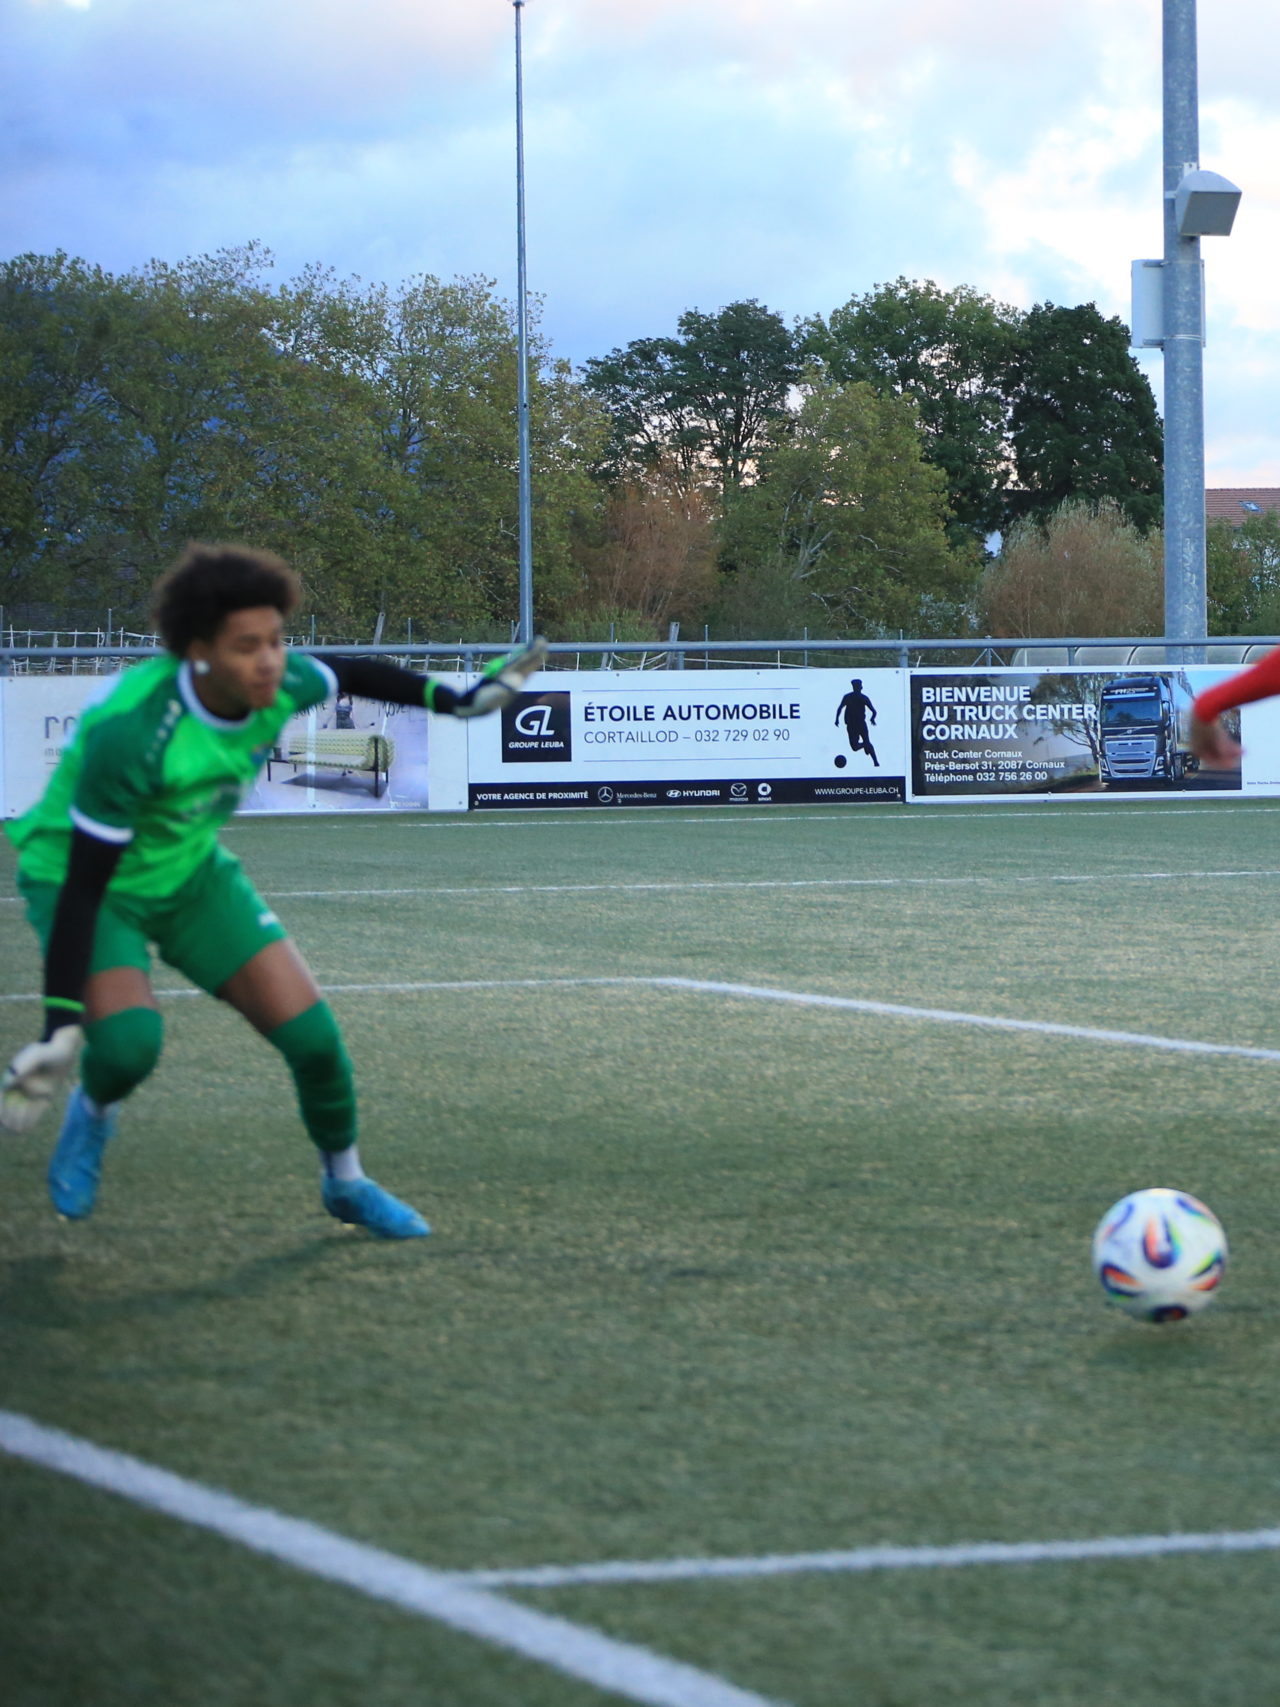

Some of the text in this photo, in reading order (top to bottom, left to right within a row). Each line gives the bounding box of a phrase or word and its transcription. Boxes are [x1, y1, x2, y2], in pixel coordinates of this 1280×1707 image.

[922, 686, 1031, 703] BIENVENUE
[584, 702, 800, 721] ÉTOILE AUTOMOBILE
[922, 704, 1097, 722] AU TRUCK CENTER
[515, 705, 555, 736] GL
[584, 730, 678, 744] CORTAILLOD
[695, 730, 720, 742] 032
[724, 729, 748, 741] 729
[753, 729, 769, 741] 02
[773, 728, 790, 741] 90
[922, 724, 1018, 740] CORNAUX
[925, 749, 1023, 759] Truck Center Cornaux
[981, 761, 996, 770] 31,
[998, 761, 1022, 769] 2087
[1026, 760, 1065, 769] Cornaux
[925, 772, 1048, 784] Téléphone 032 756 26 00
[549, 791, 589, 799] PROXIMITÉ
[815, 787, 899, 795] WWW.GROUPE-LEUBA.CH
